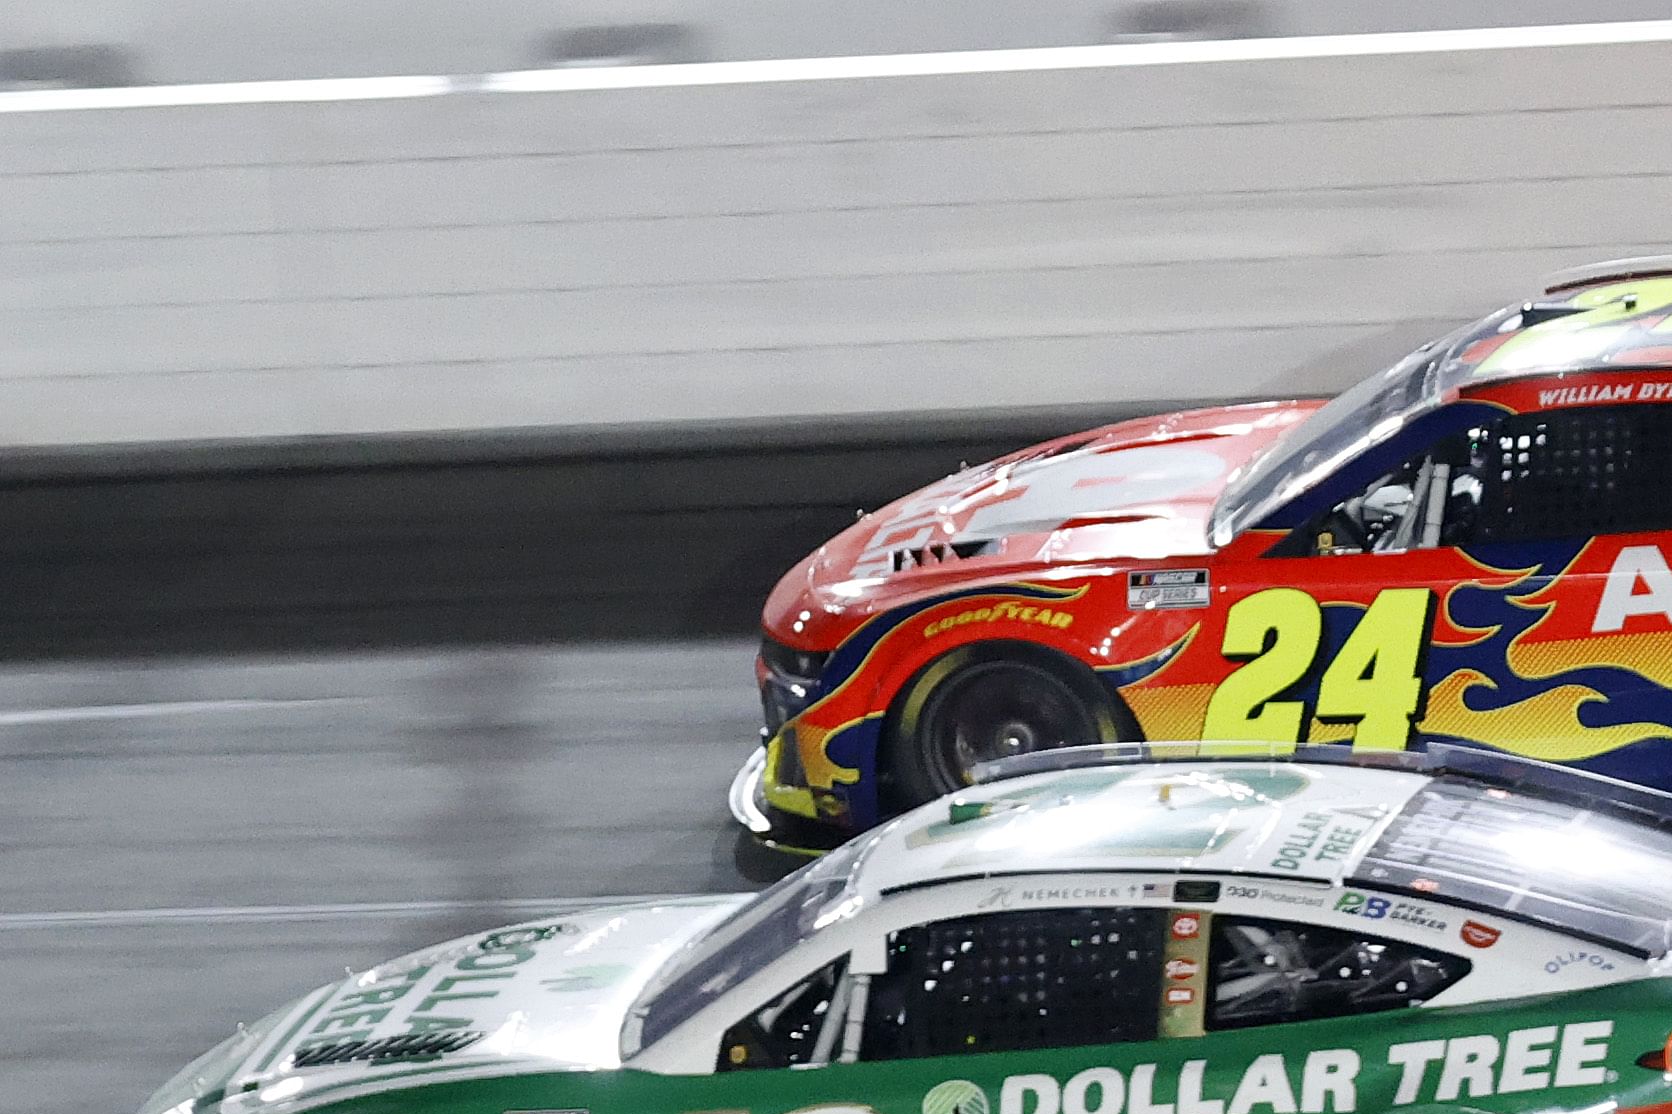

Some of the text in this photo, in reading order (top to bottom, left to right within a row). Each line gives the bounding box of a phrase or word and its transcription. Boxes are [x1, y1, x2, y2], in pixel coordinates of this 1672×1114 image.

[1538, 384, 1632, 407] WILLIAM
[923, 600, 1074, 637] GOODYEAR
[1200, 587, 1434, 757] 24
[1021, 887, 1120, 900] NEMECHEK
[1387, 1020, 1615, 1104] TREE
